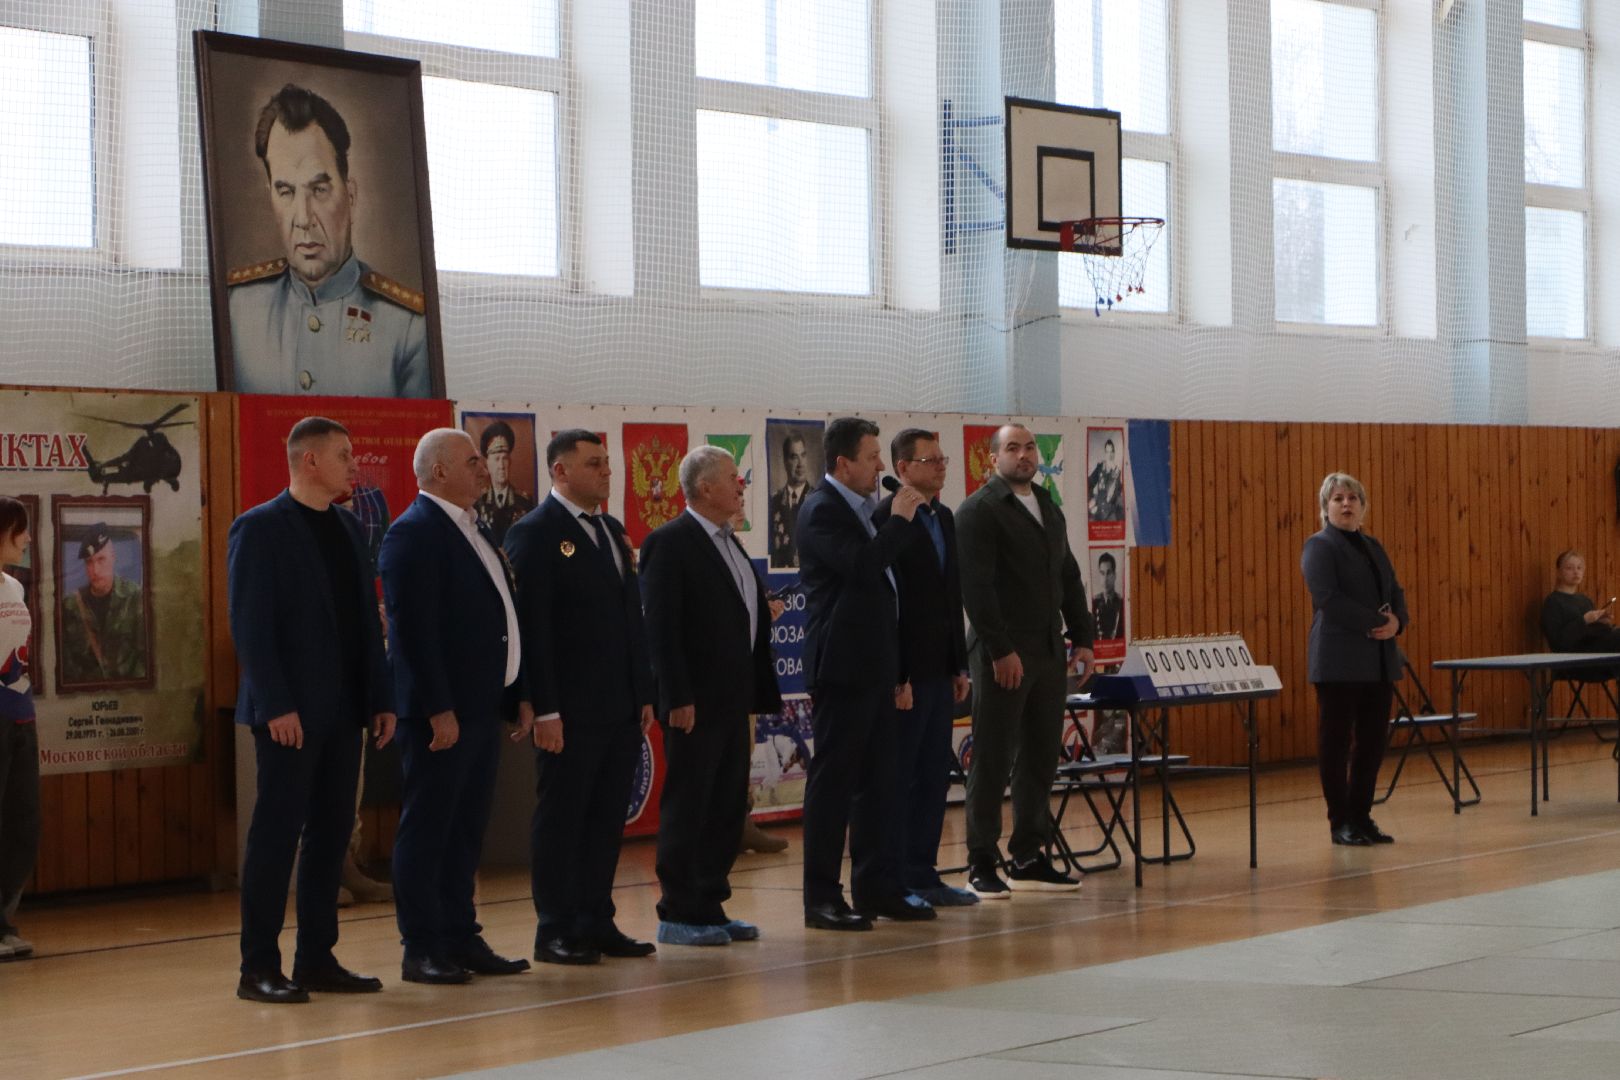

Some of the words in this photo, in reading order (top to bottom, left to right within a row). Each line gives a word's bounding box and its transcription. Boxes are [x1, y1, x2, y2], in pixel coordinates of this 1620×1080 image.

[776, 658, 803, 675] ОВА
[1145, 652, 1158, 673] 0
[1159, 651, 1171, 672] 0
[1173, 650, 1185, 671] 0
[1187, 649, 1198, 670] 0
[1200, 648, 1211, 669] 0
[1213, 648, 1225, 668] 0
[1226, 647, 1238, 667] 0
[1239, 646, 1250, 666] 0
[40, 745, 128, 765] Московской
